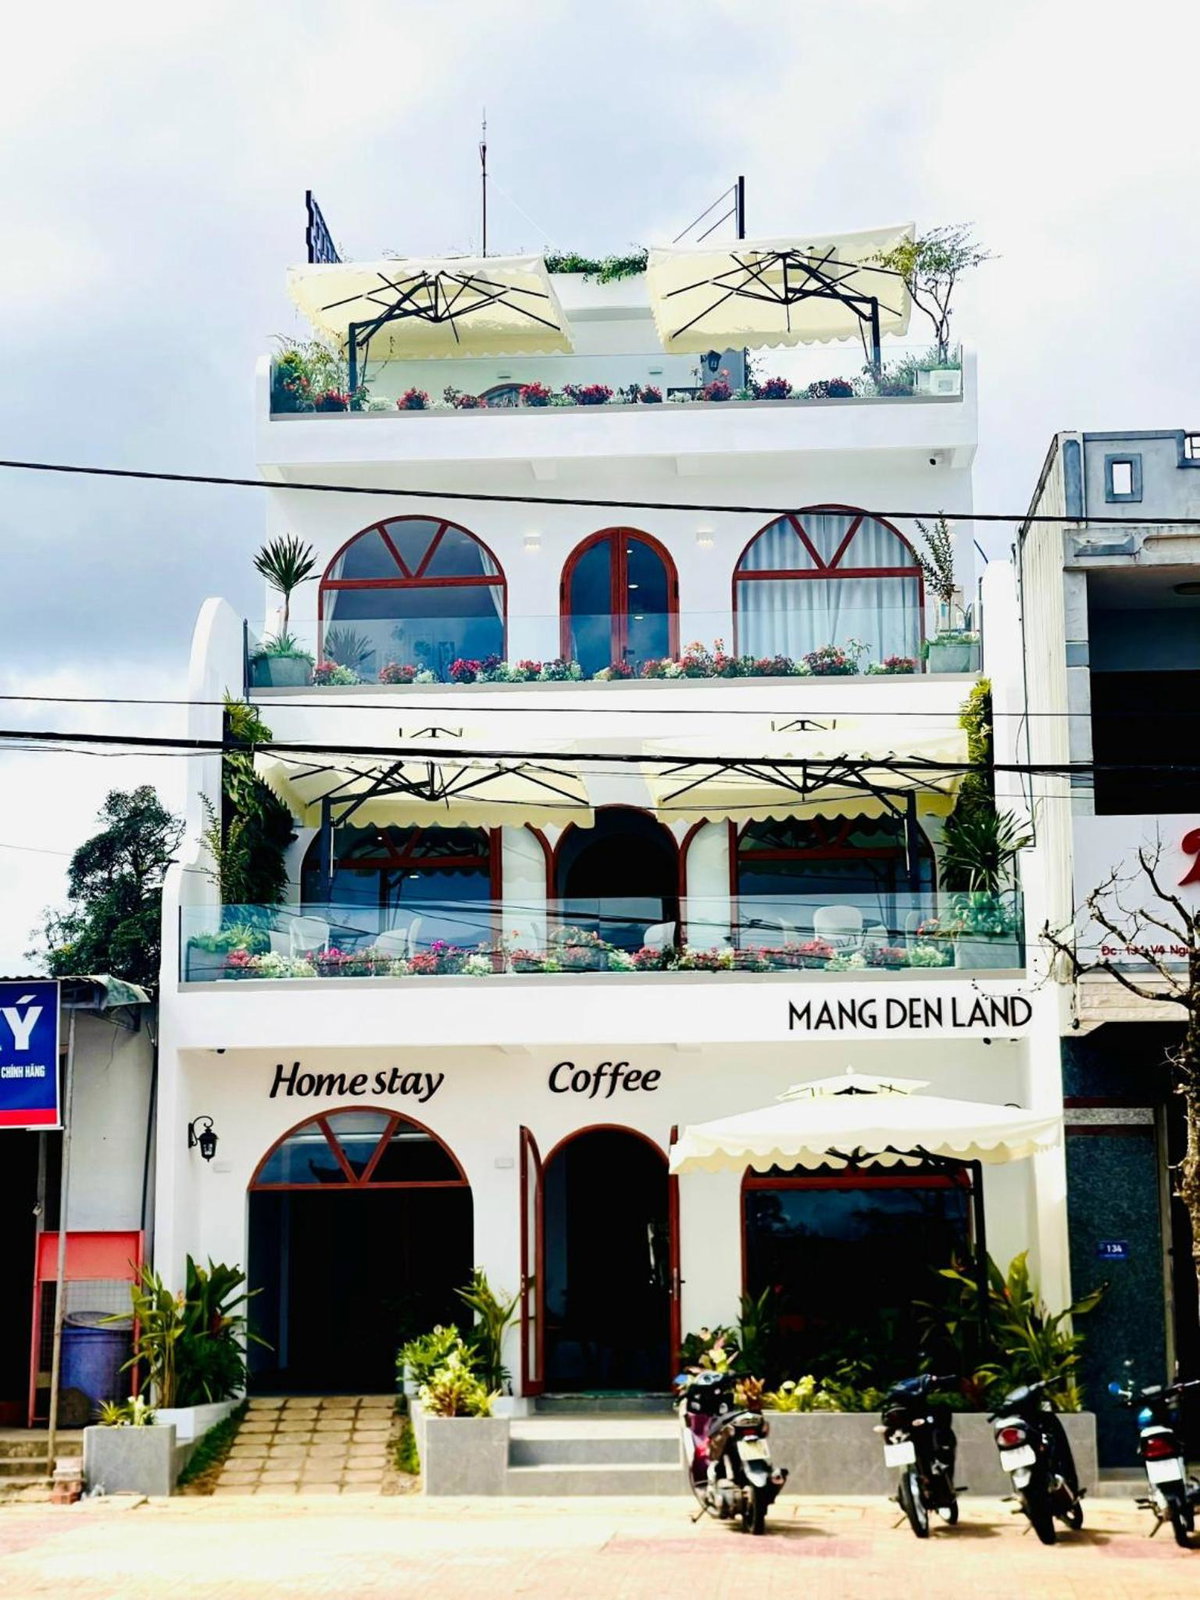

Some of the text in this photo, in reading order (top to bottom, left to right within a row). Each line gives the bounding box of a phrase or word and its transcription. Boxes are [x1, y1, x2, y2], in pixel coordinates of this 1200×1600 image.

[0, 994, 44, 1051] Ý
[788, 996, 1033, 1031] MANG DEN LAND
[547, 1061, 662, 1099] Coffee
